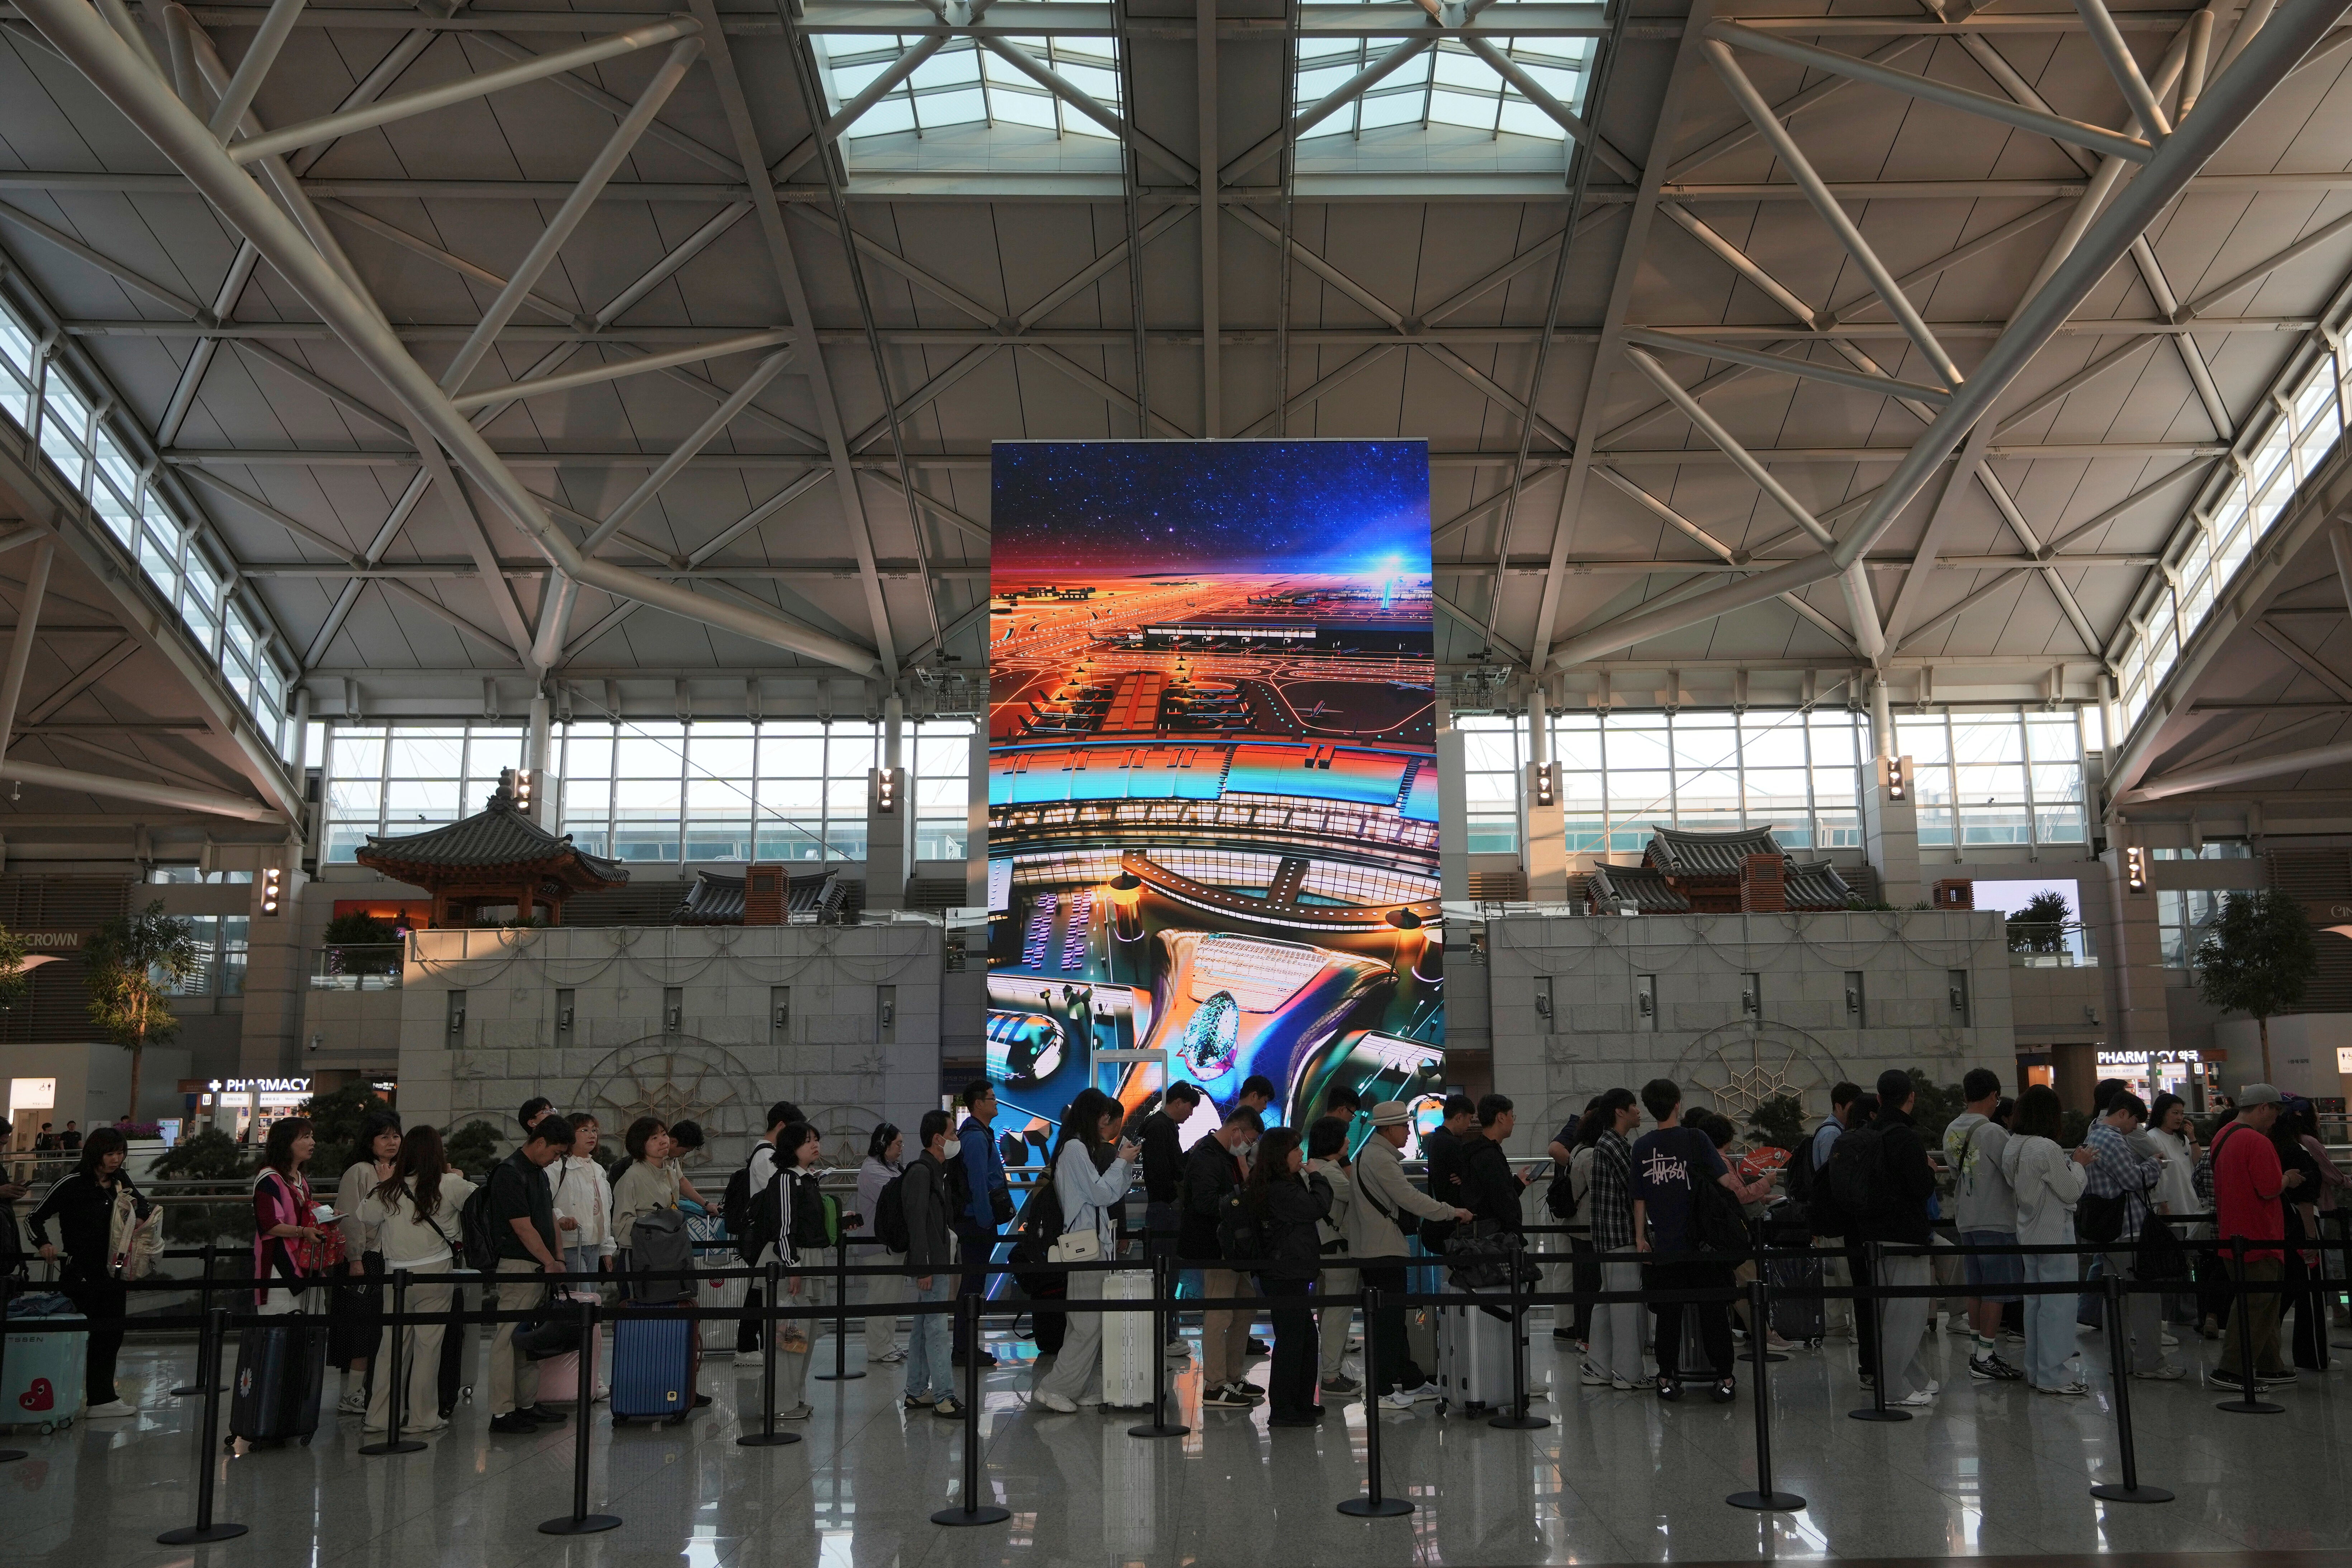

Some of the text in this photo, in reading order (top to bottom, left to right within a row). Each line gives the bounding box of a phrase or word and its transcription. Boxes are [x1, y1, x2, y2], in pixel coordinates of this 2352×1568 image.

[25, 933, 78, 946] CROWN
[2097, 1050, 2199, 1064] PHARMCY 약국
